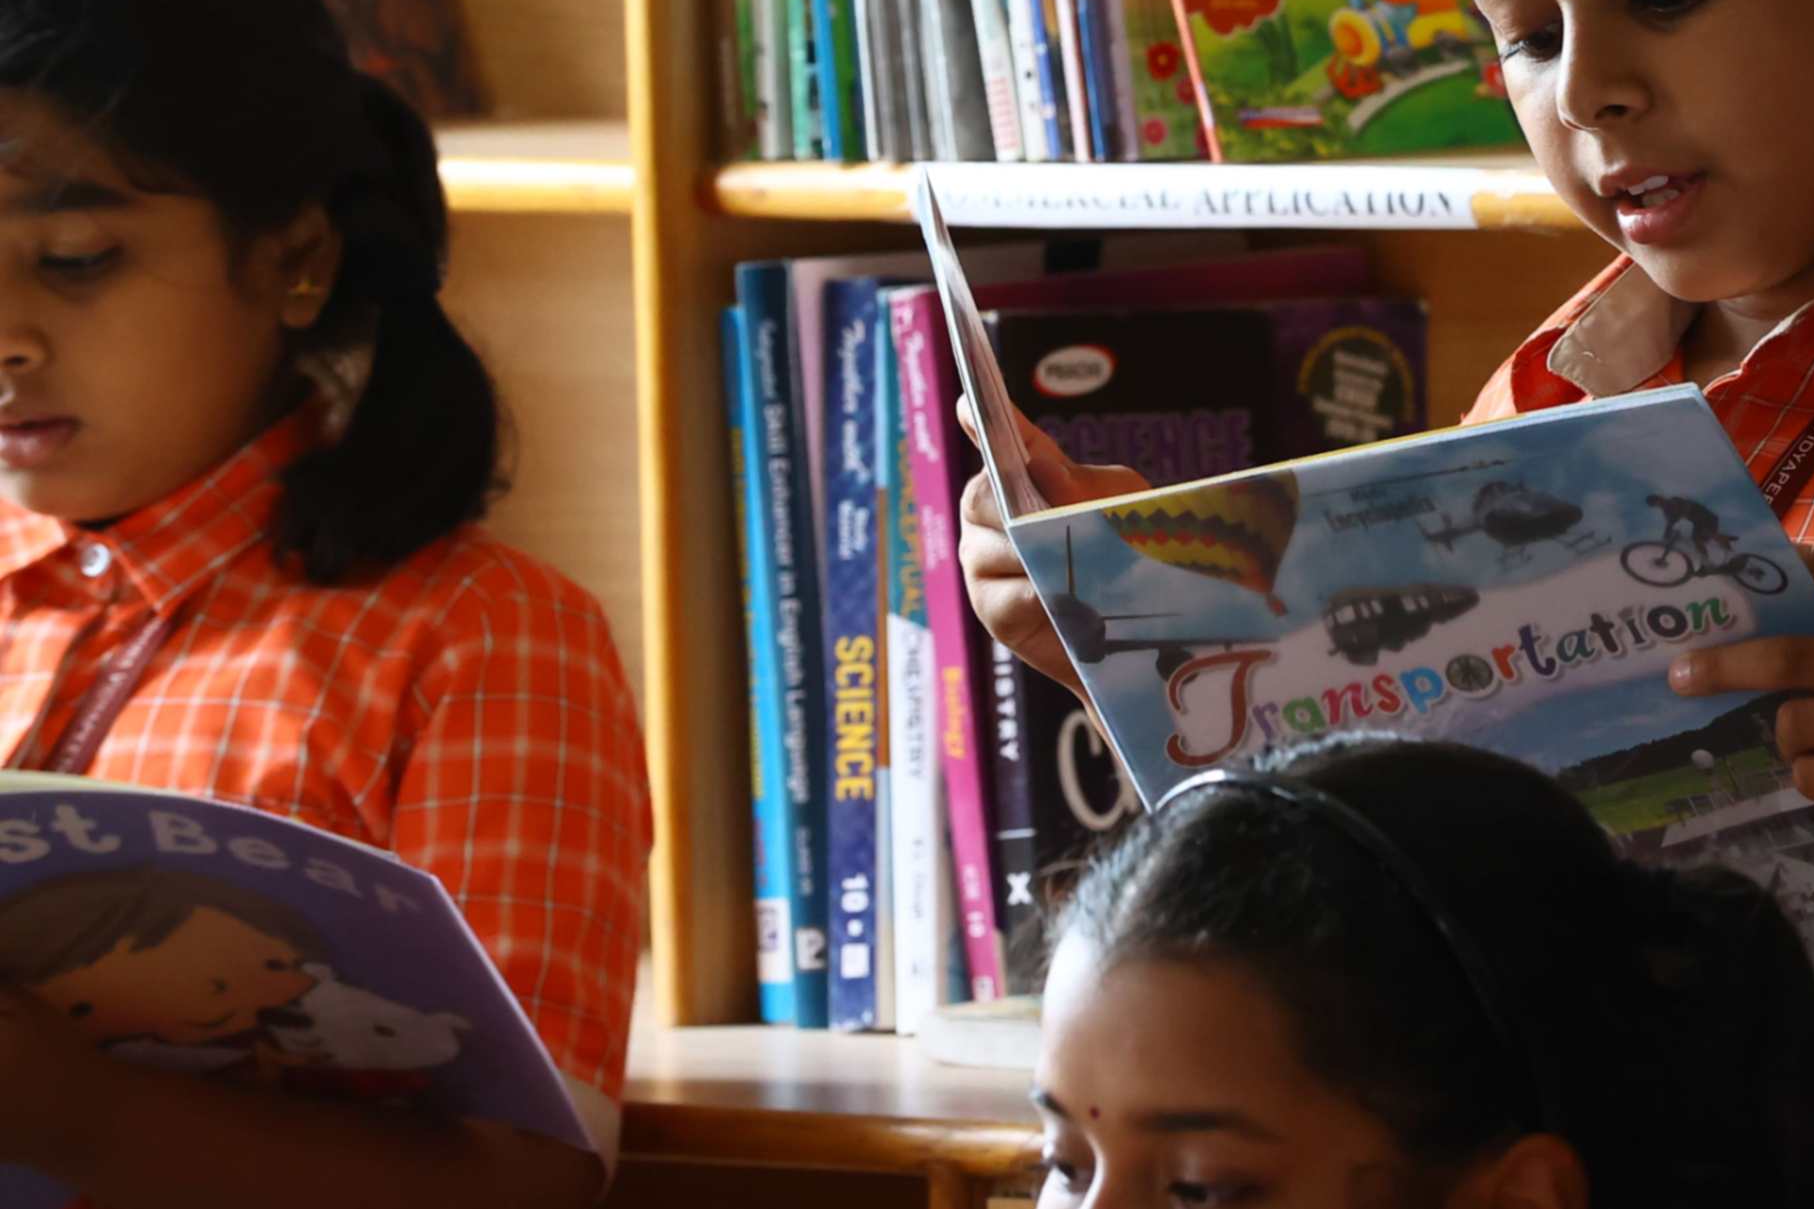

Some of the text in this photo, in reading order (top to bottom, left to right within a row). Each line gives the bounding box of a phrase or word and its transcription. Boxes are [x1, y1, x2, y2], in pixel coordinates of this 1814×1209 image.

[1193, 187, 1456, 219] APPLICATION
[767, 457, 794, 567] Enhancer
[774, 597, 802, 690] English
[1165, 589, 1737, 770] Transportation
[781, 690, 808, 803] Language
[834, 635, 875, 801] SCIENCE
[937, 665, 972, 760] Biology
[150, 810, 423, 913] Bear
[841, 872, 869, 912] 10
[1006, 871, 1033, 905] X
